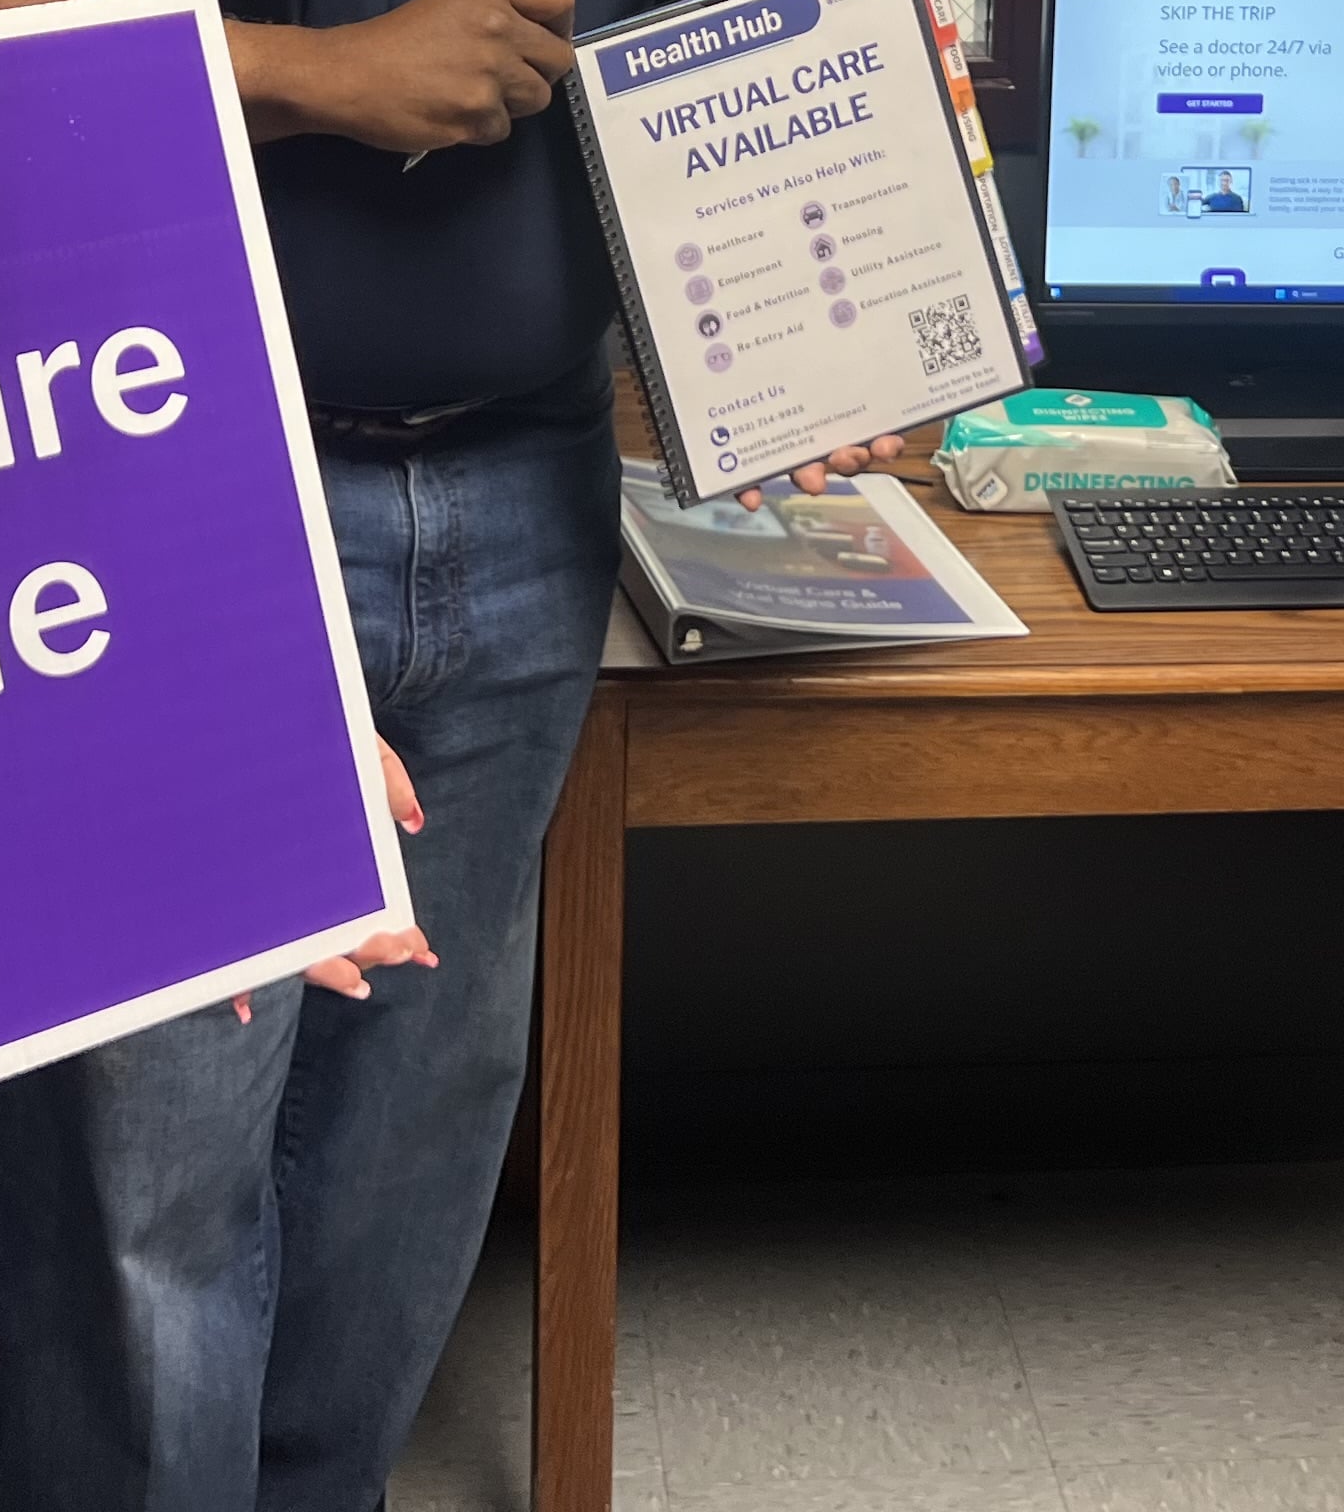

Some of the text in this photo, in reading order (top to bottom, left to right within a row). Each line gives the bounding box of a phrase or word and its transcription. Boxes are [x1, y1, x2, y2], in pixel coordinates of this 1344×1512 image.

[1160, 5, 1276, 21] SKIP THE TRIP
[624, 7, 783, 77] Health Hub
[1158, 39, 1332, 55] See a doctor 24/7 via
[1156, 62, 1288, 81] video or phone.
[640, 42, 885, 143] VIRTUAL CARE
[686, 91, 873, 178] AVAILABLE
[695, 148, 887, 220] Services We Also Help With:
[831, 181, 909, 212] Transportation
[707, 229, 765, 255] Healthcare
[841, 225, 884, 246] Housing
[717, 259, 784, 288] Employment
[850, 241, 943, 278] Utility Assistance
[726, 285, 810, 321] Food & Nutrition
[859, 268, 964, 310] Education Assistance
[786, 322, 805, 335] Aid
[707, 385, 786, 419] Contact Us
[1031, 406, 1137, 417] DISINFECTING
[1023, 471, 1196, 492] DISINFECTING
